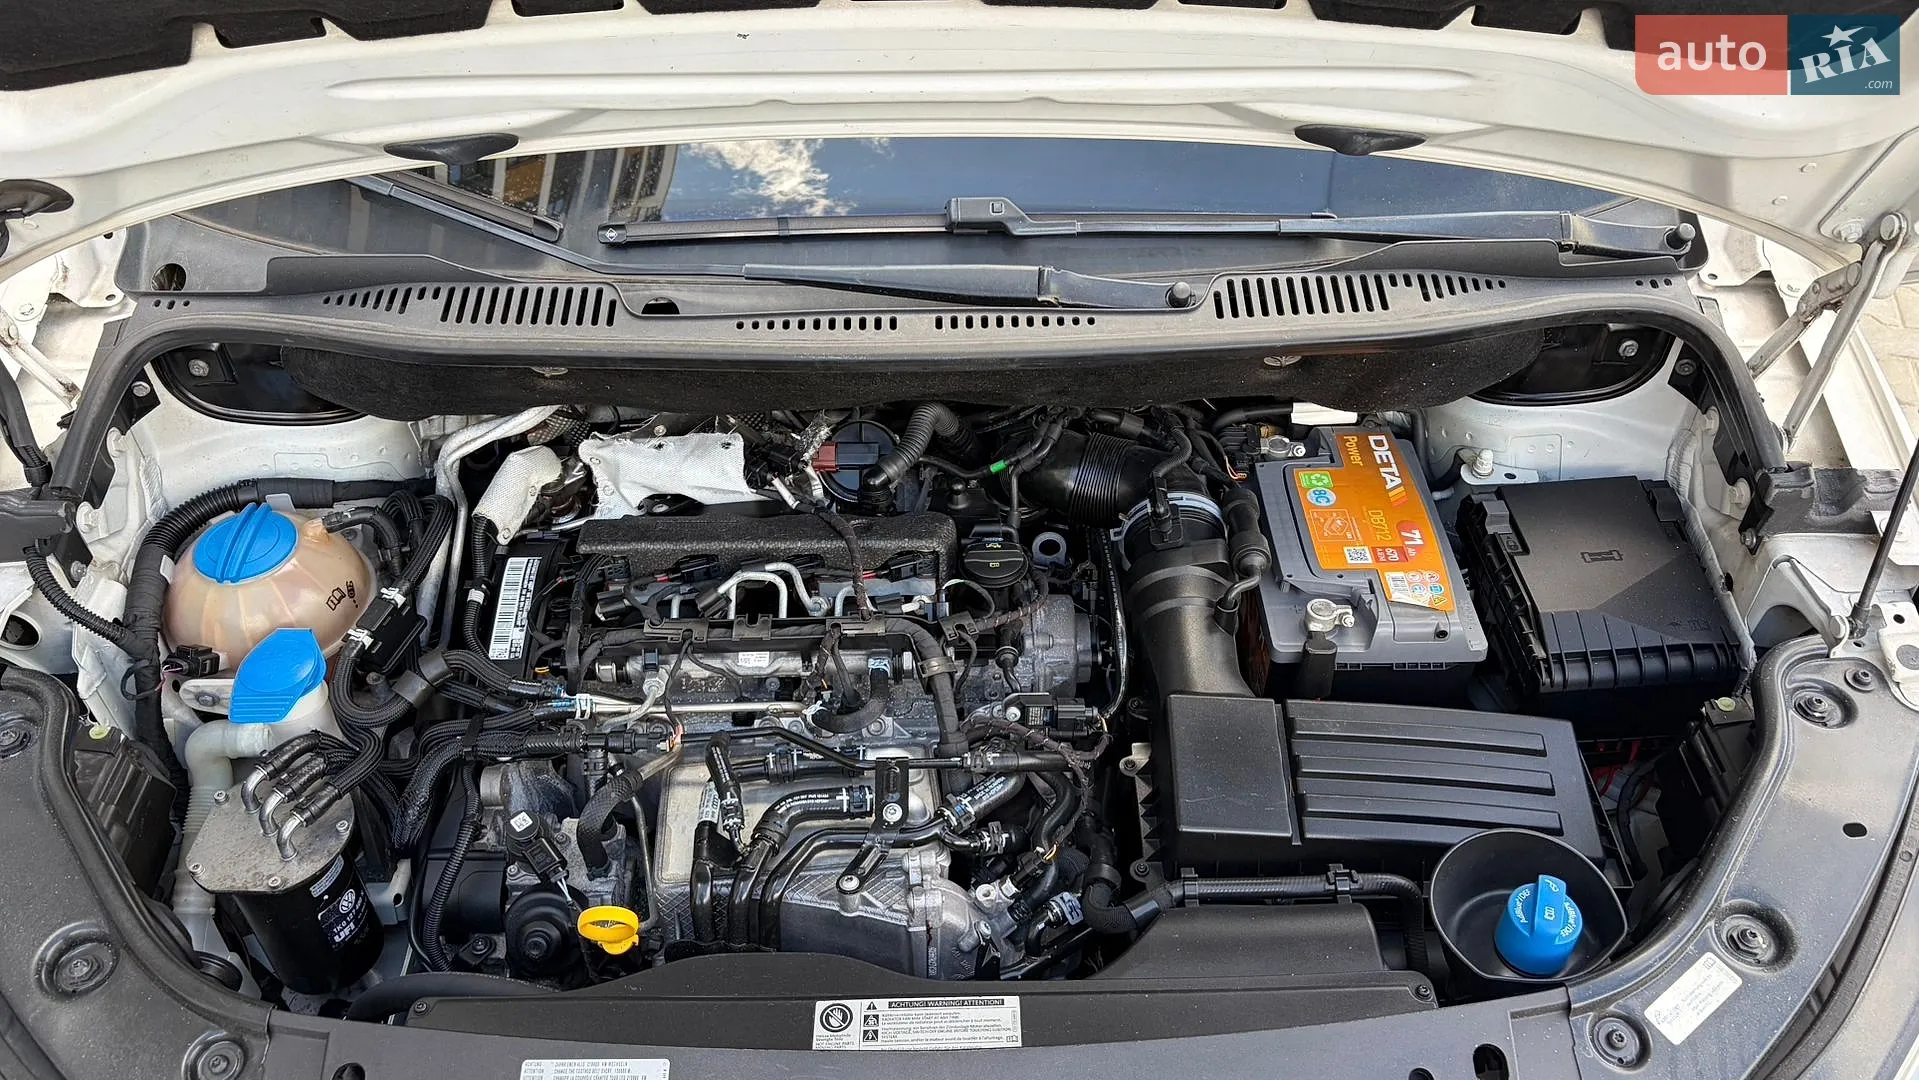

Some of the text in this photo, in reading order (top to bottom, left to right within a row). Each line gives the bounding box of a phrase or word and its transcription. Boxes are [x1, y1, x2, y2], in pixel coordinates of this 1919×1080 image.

[1343, 435, 1364, 467] Power
[1368, 435, 1402, 490] DETA
[1368, 509, 1392, 541] DB712
[1400, 529, 1424, 545] 71
[333, 922, 355, 943] UFI
[891, 998, 1003, 1009] ACHTUNG! WARNING! ATTENTION!
